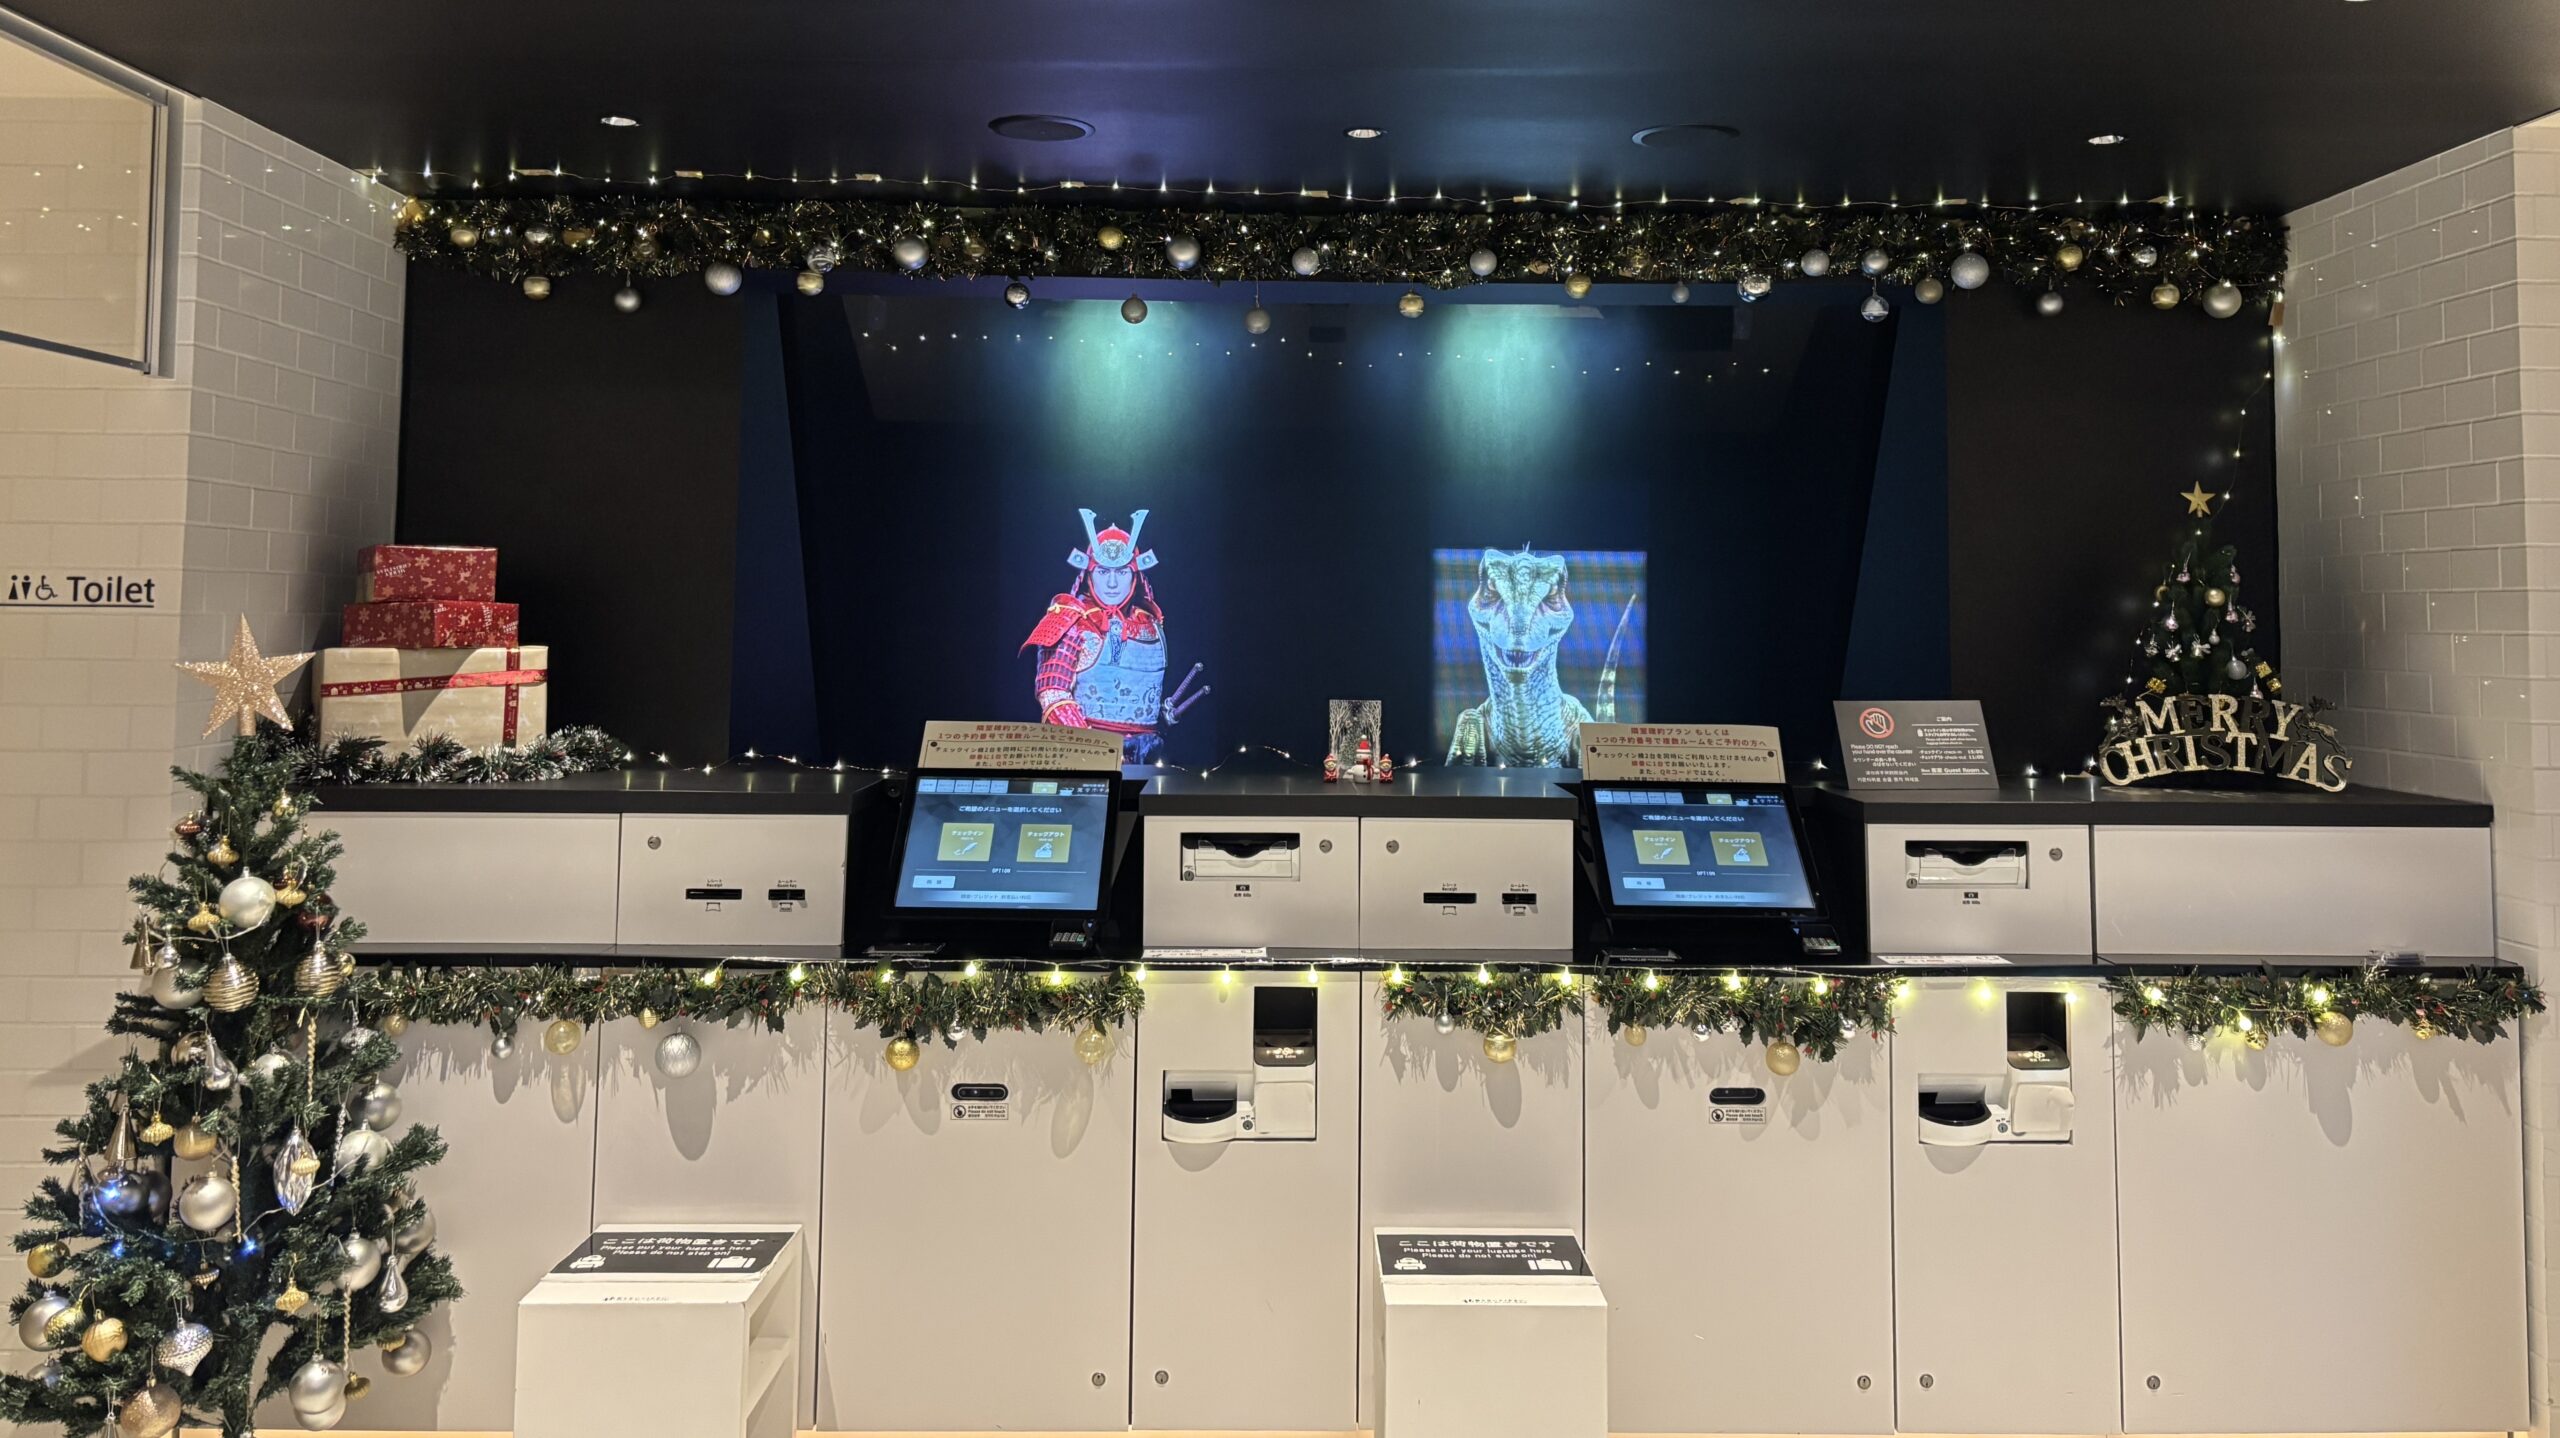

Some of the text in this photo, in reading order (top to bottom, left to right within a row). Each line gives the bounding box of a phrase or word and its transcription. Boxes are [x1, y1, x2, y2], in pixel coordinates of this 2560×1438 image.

[66, 576, 155, 602] Toilet
[1041, 726, 1074, 734] もしくは
[2135, 693, 2304, 742] MERRY
[2098, 731, 2353, 793] CHRISTMAS
